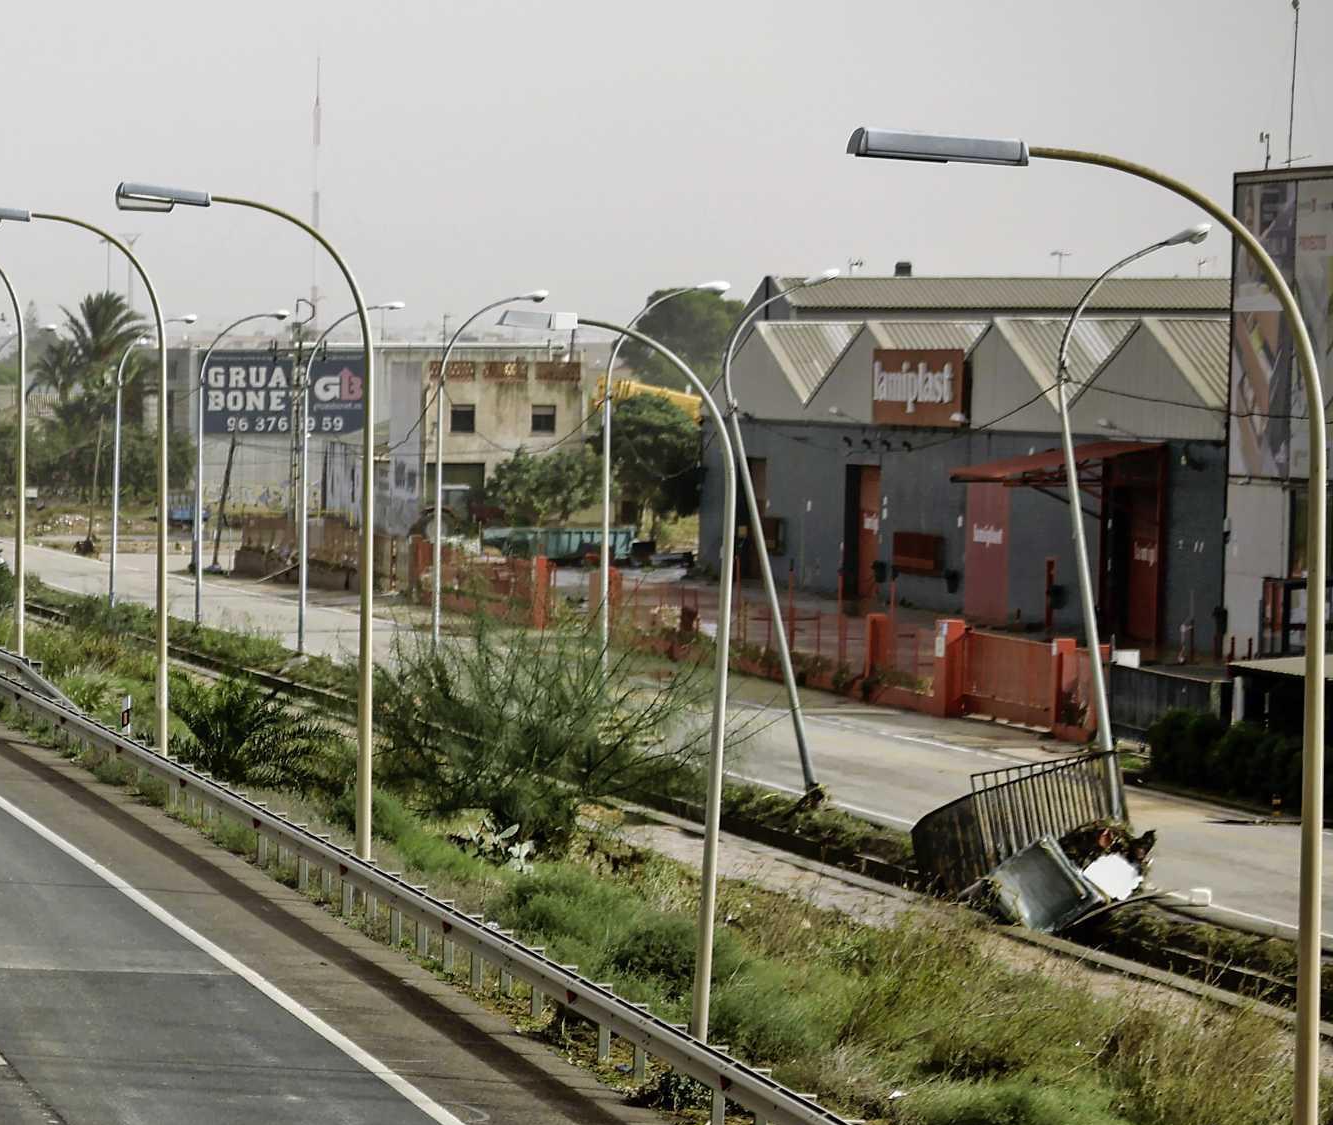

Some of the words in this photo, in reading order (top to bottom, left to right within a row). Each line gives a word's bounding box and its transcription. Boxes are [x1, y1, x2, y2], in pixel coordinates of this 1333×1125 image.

[873, 360, 955, 414] lamiplast
[226, 416, 250, 432] 96
[254, 416, 289, 432] 376
[321, 416, 344, 432] 59
